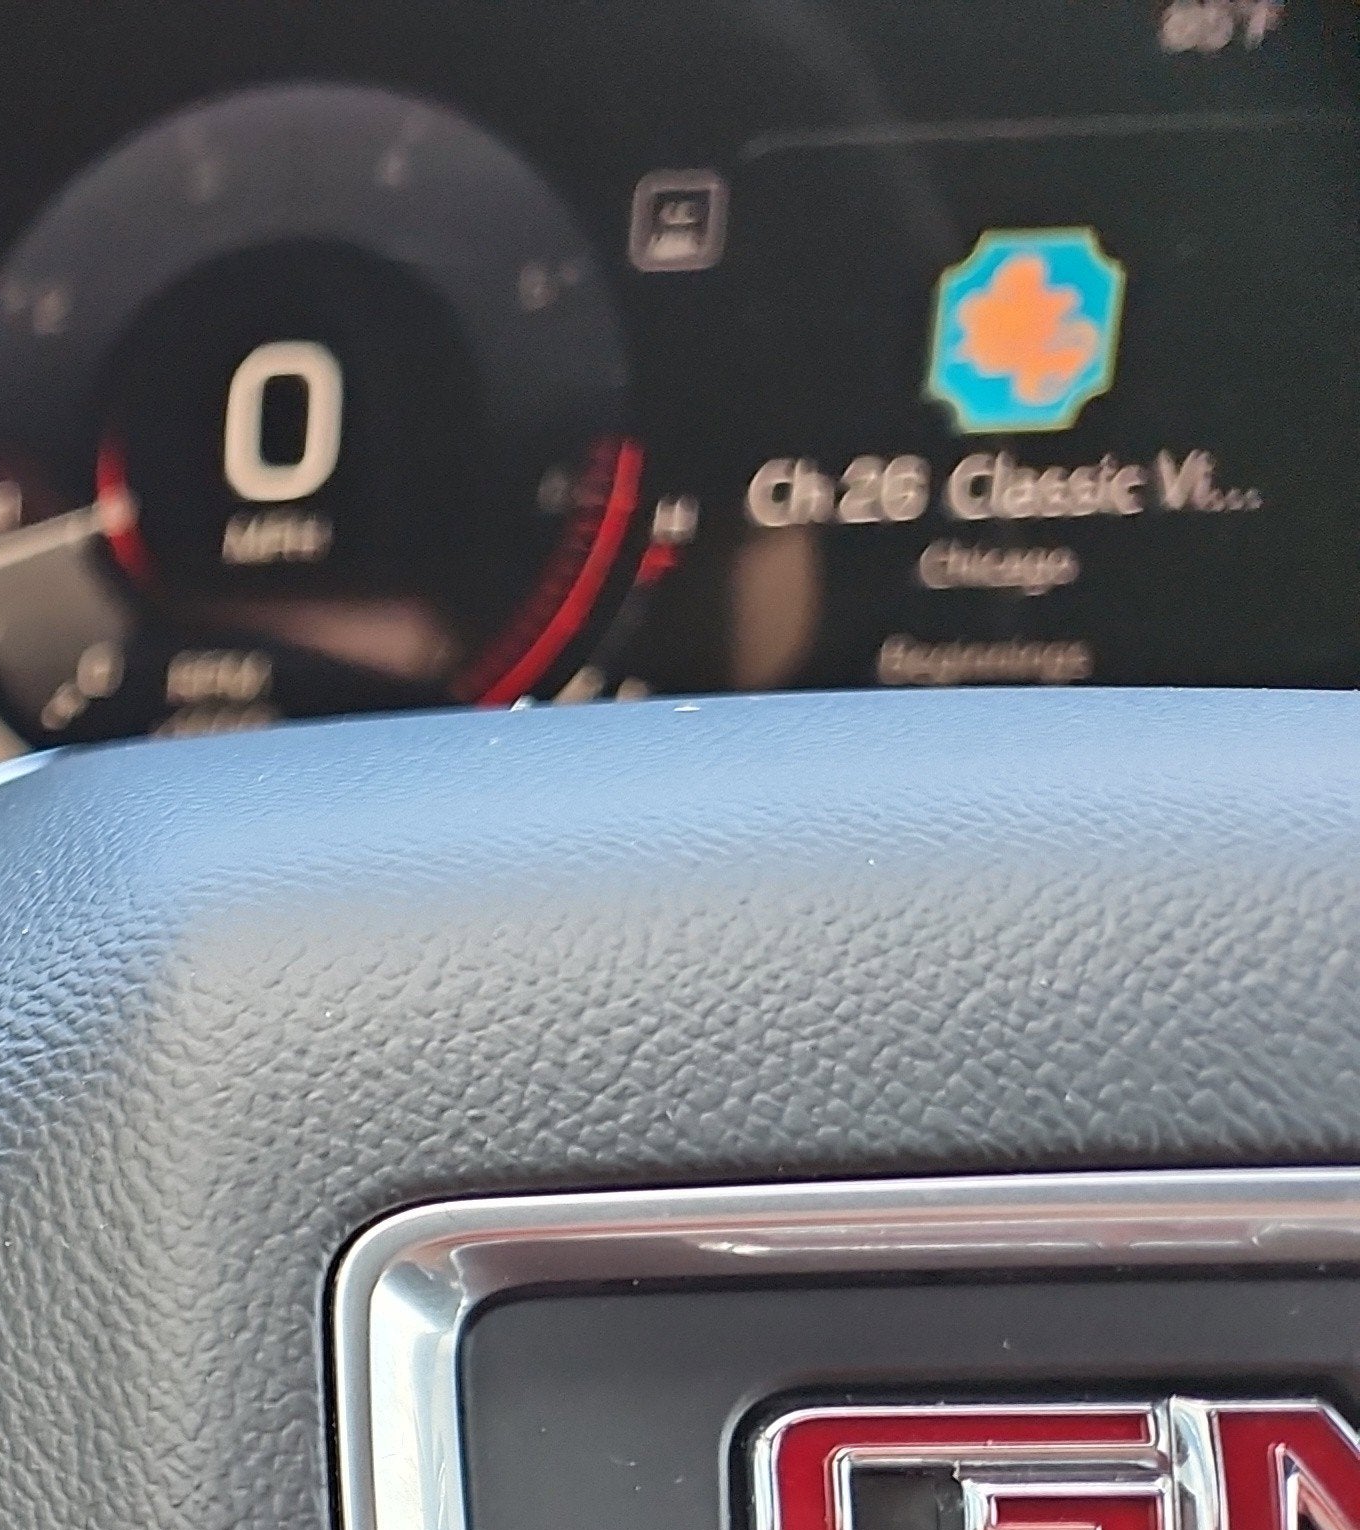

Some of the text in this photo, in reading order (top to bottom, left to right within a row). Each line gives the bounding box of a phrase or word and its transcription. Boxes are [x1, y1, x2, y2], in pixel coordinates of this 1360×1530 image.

[224, 341, 342, 501] 0
[746, 458, 834, 530] Ch
[838, 454, 928, 523] 26
[947, 450, 1146, 520] Classic
